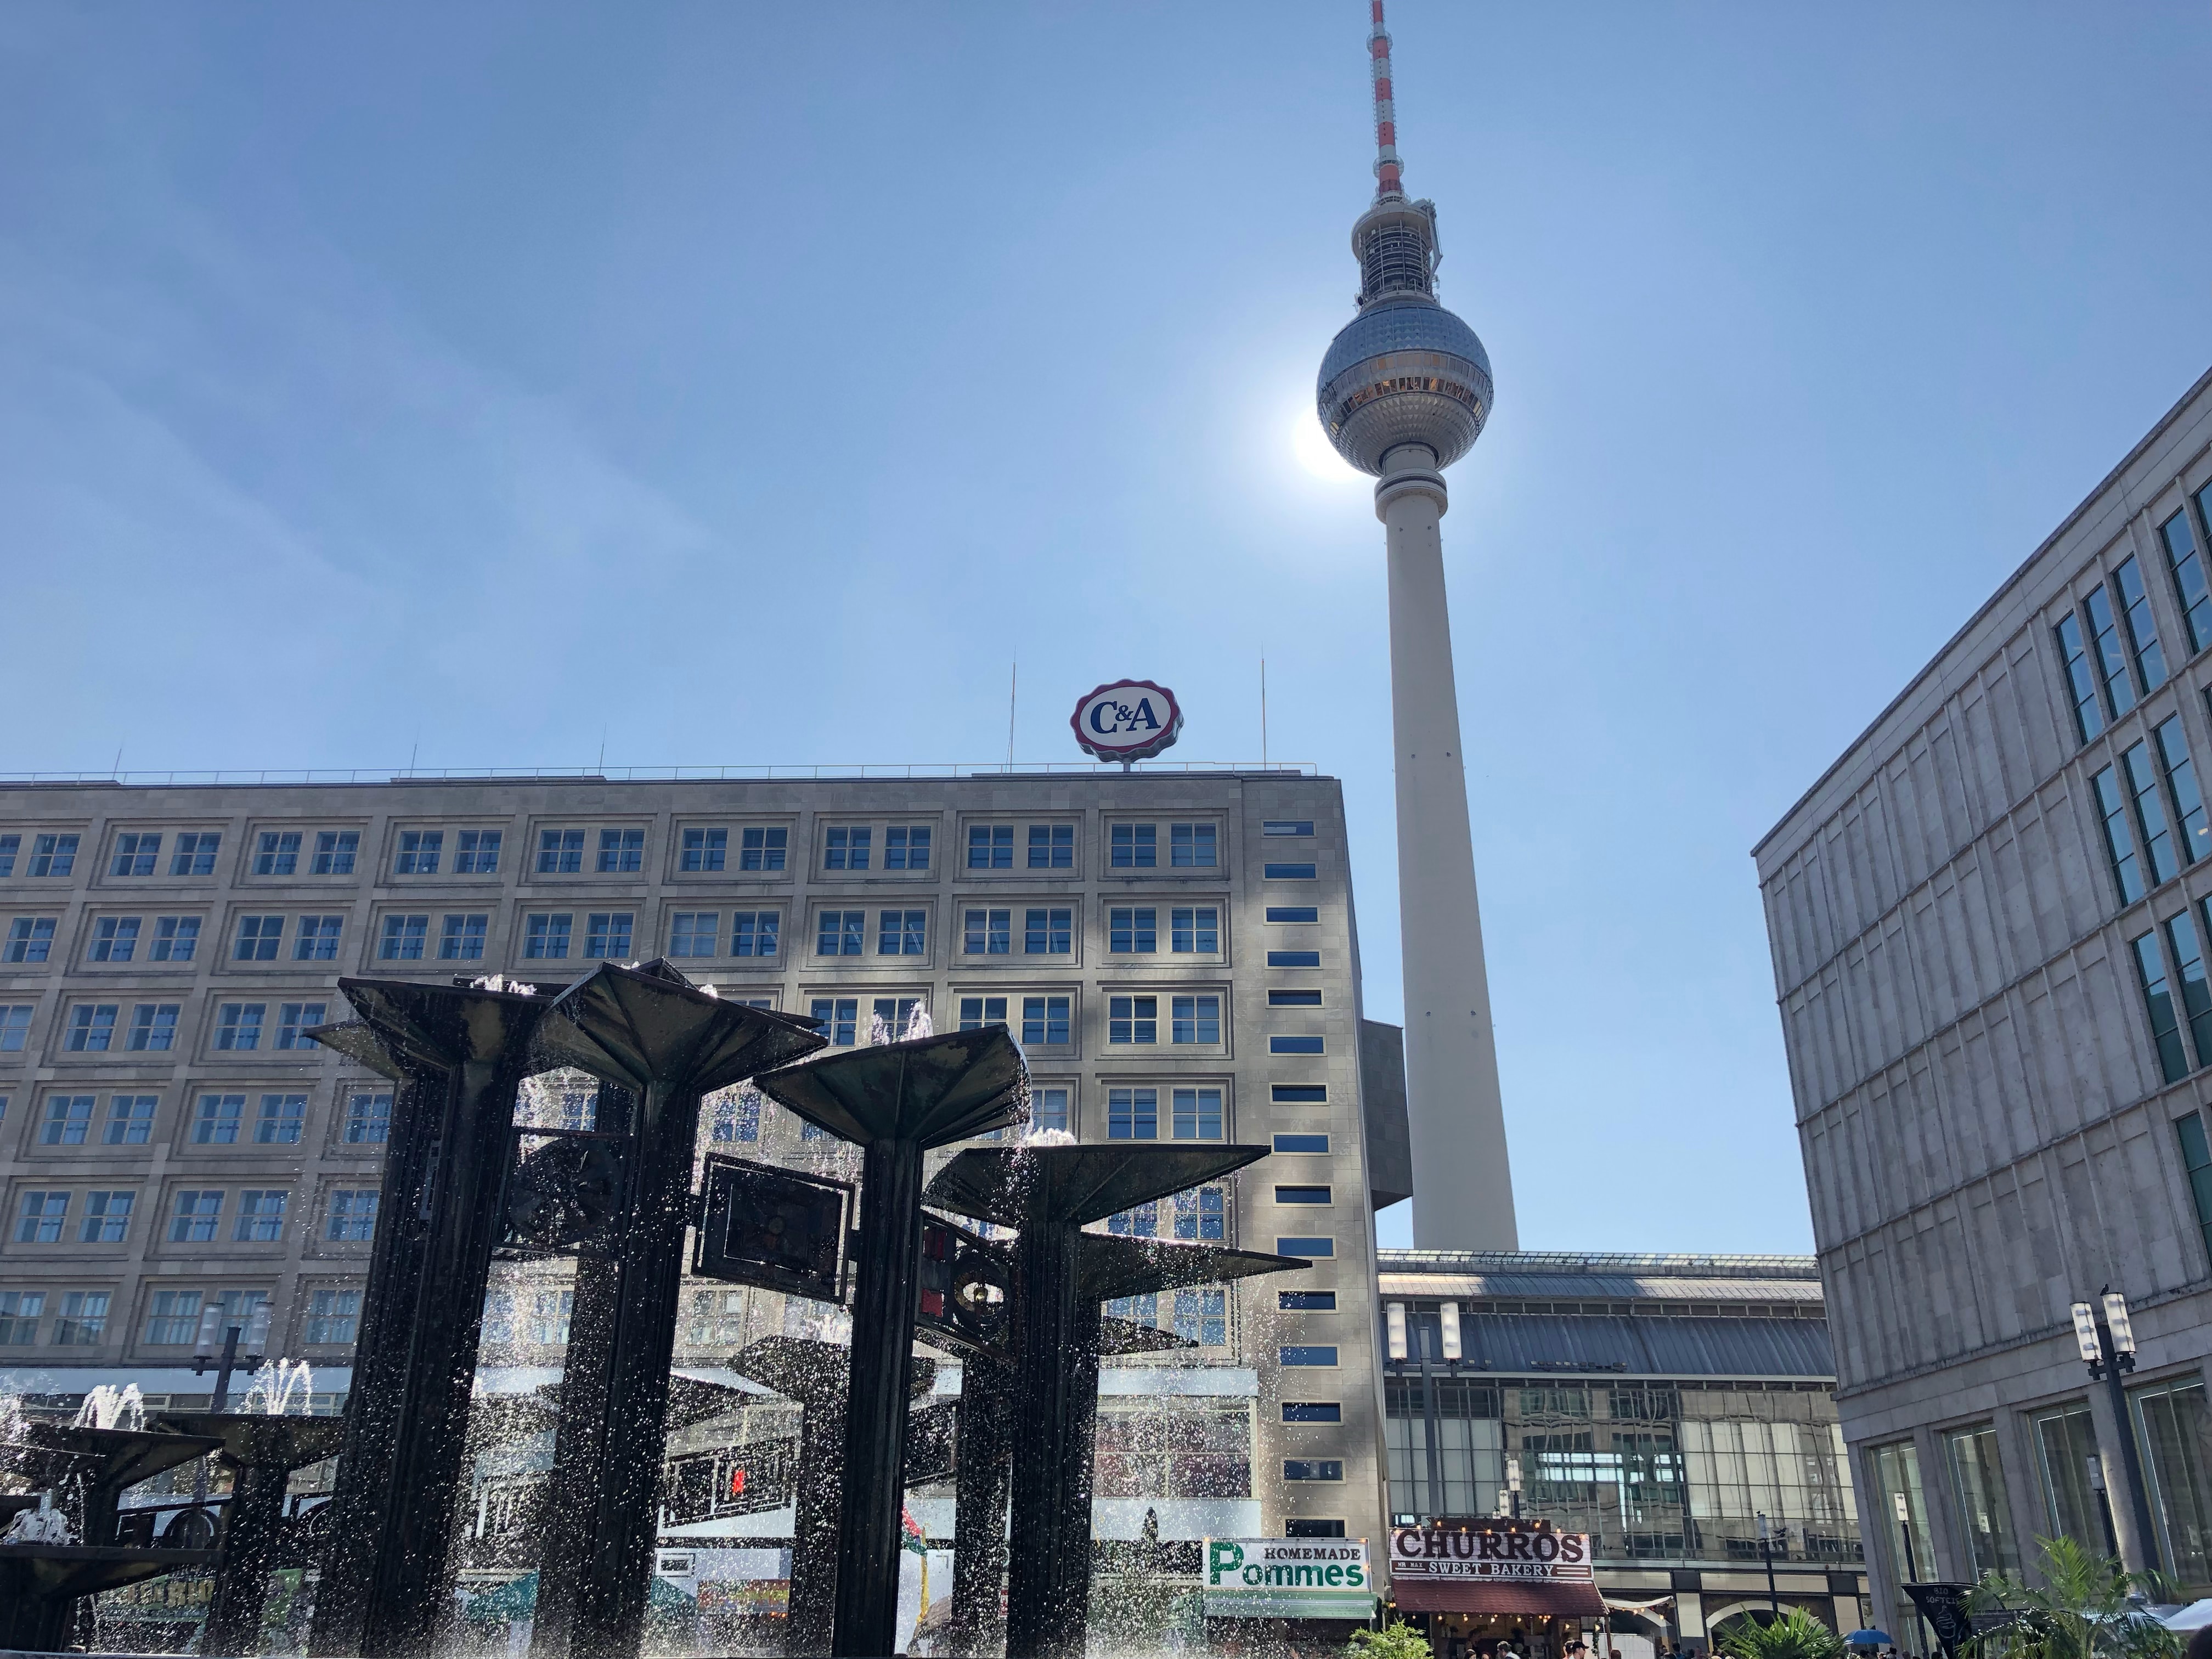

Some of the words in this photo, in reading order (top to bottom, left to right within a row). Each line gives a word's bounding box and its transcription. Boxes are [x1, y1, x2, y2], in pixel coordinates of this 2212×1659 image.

[1090, 697, 1161, 734] C&A
[1264, 1547, 1361, 1560] HOMEMADE
[1396, 1530, 1584, 1563] CHURROS
[1210, 1542, 1364, 1587] Pommes
[1429, 1561, 1482, 1575] SWEET
[1491, 1564, 1554, 1576] BAKERY
